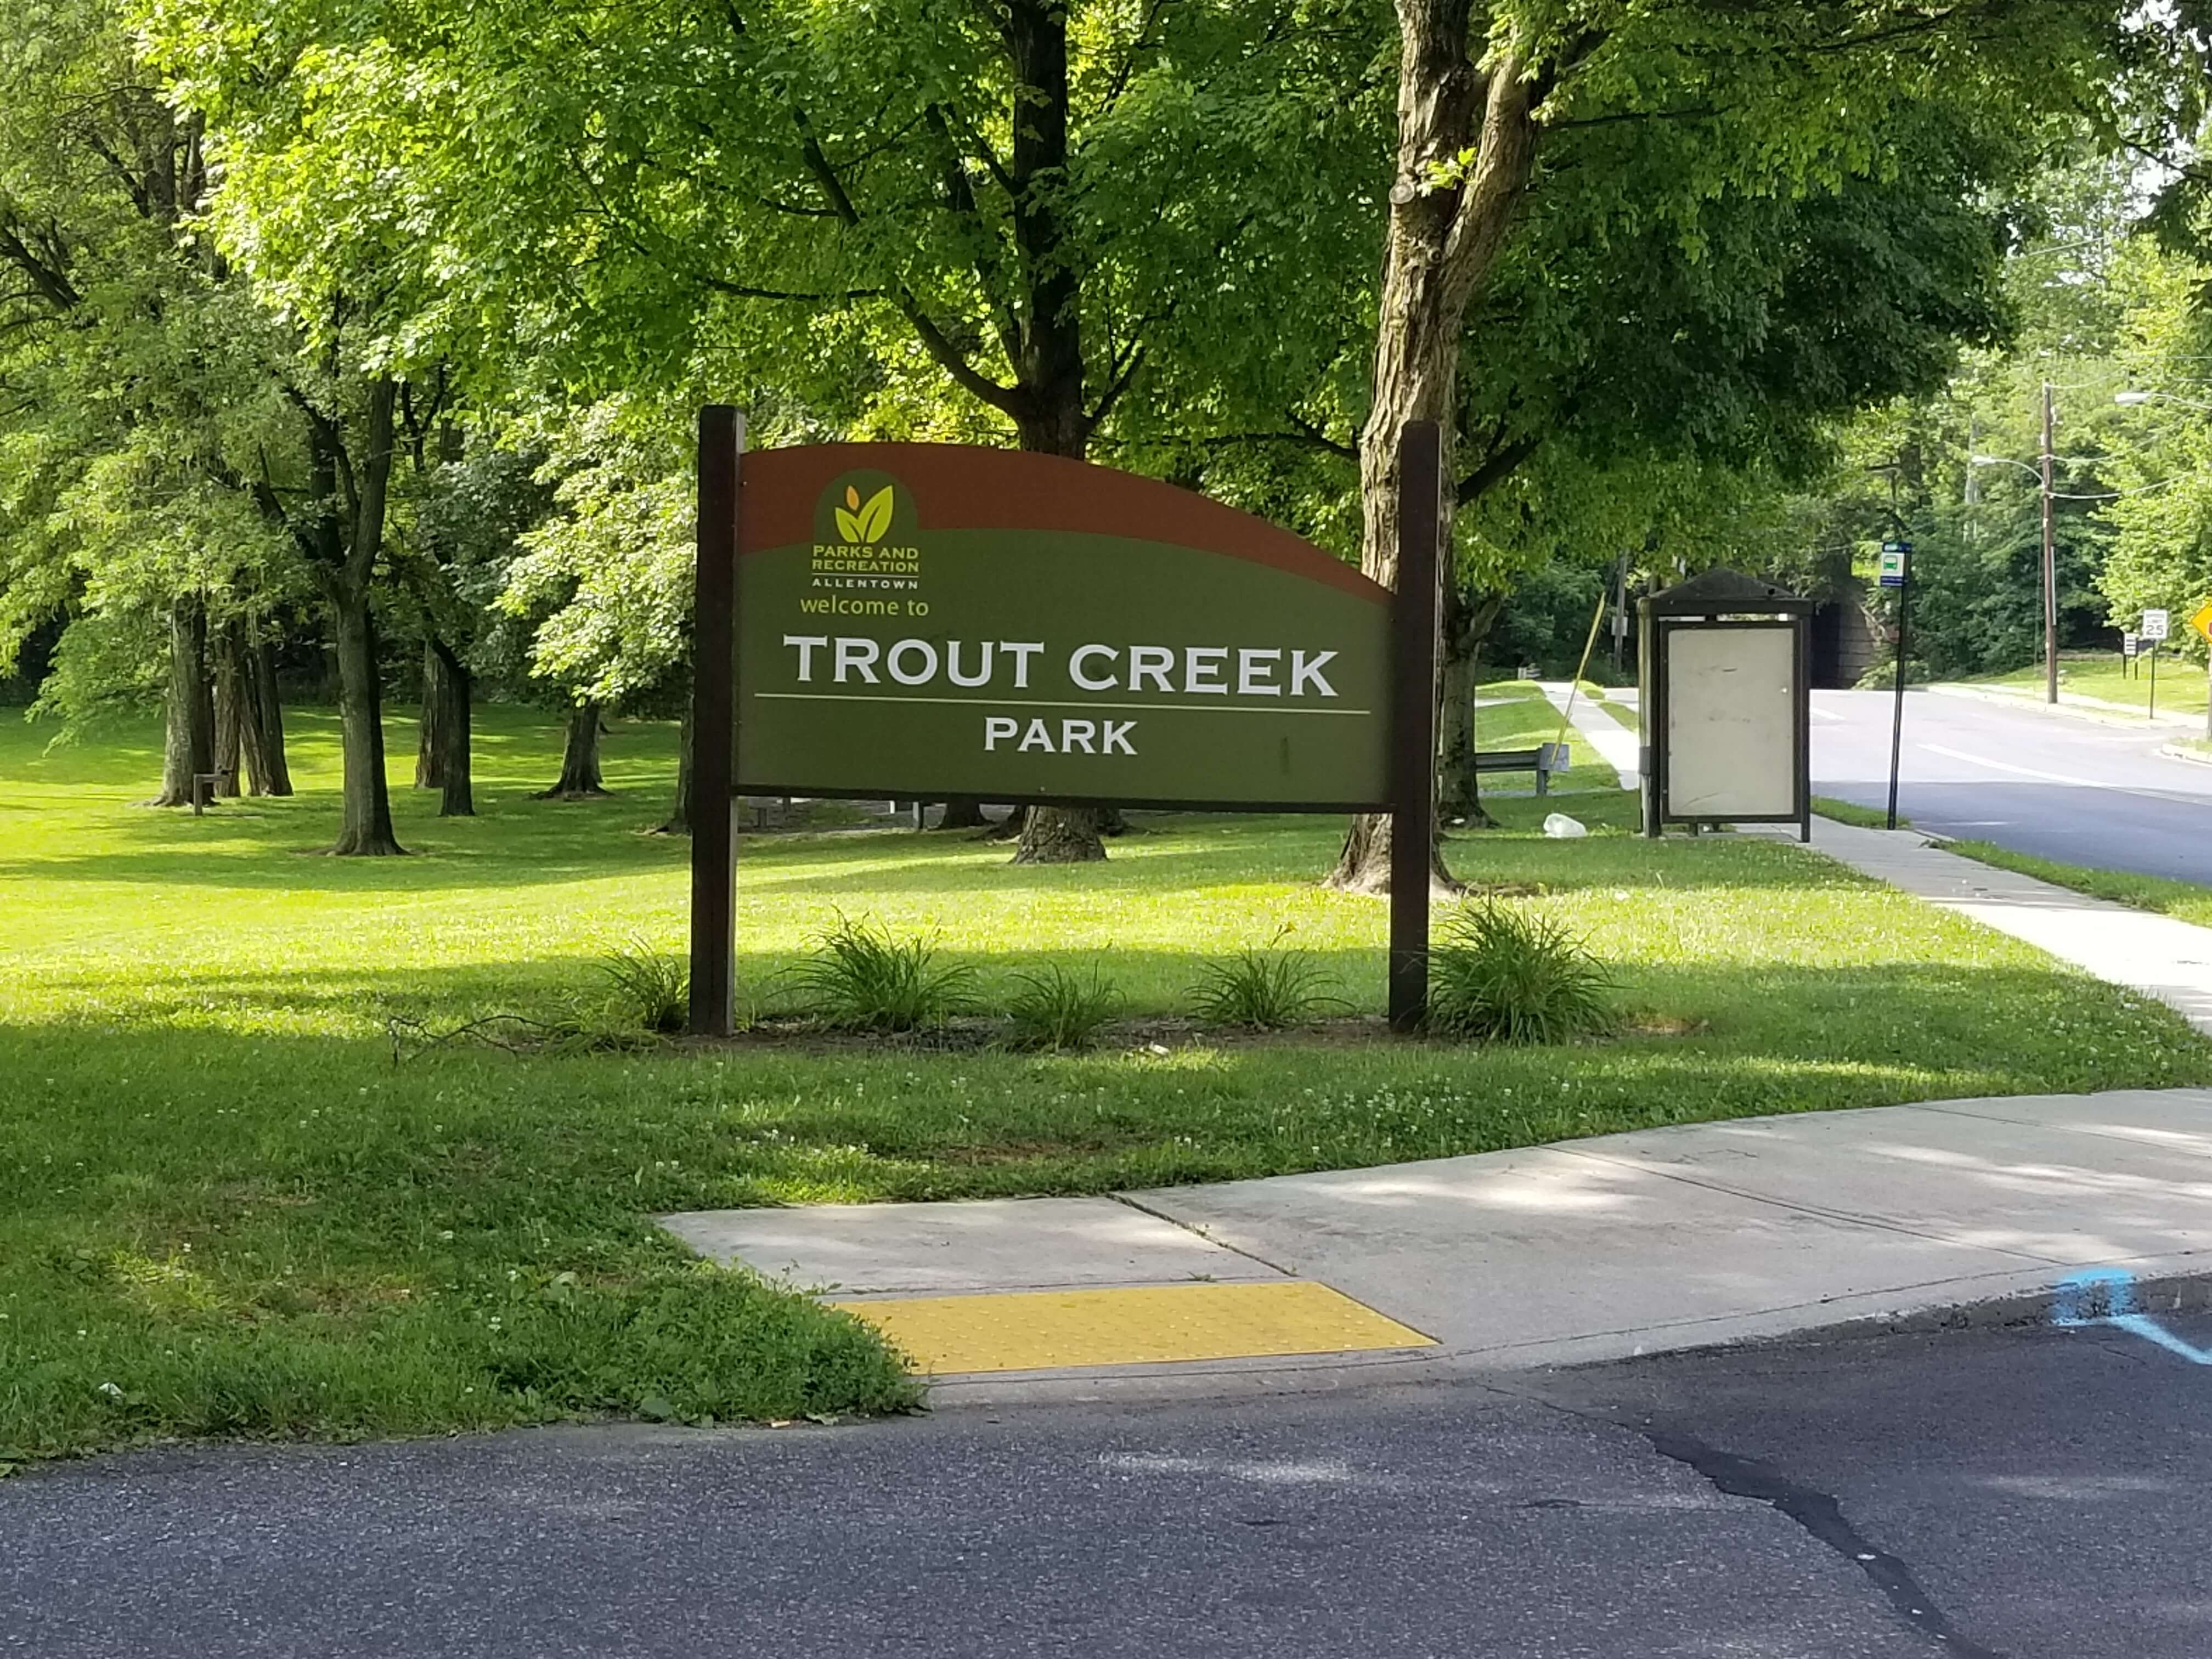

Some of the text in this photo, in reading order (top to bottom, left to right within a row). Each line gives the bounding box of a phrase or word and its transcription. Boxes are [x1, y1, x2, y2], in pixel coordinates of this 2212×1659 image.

[813, 545, 919, 559] PARKS AND
[812, 559, 919, 572] RECREATION
[812, 578, 919, 589] ALLENTOWN
[800, 595, 929, 616] welcome to
[2146, 624, 2164, 635] 25
[782, 635, 1339, 696] TROUT CREEK
[985, 718, 1137, 754] PARK
